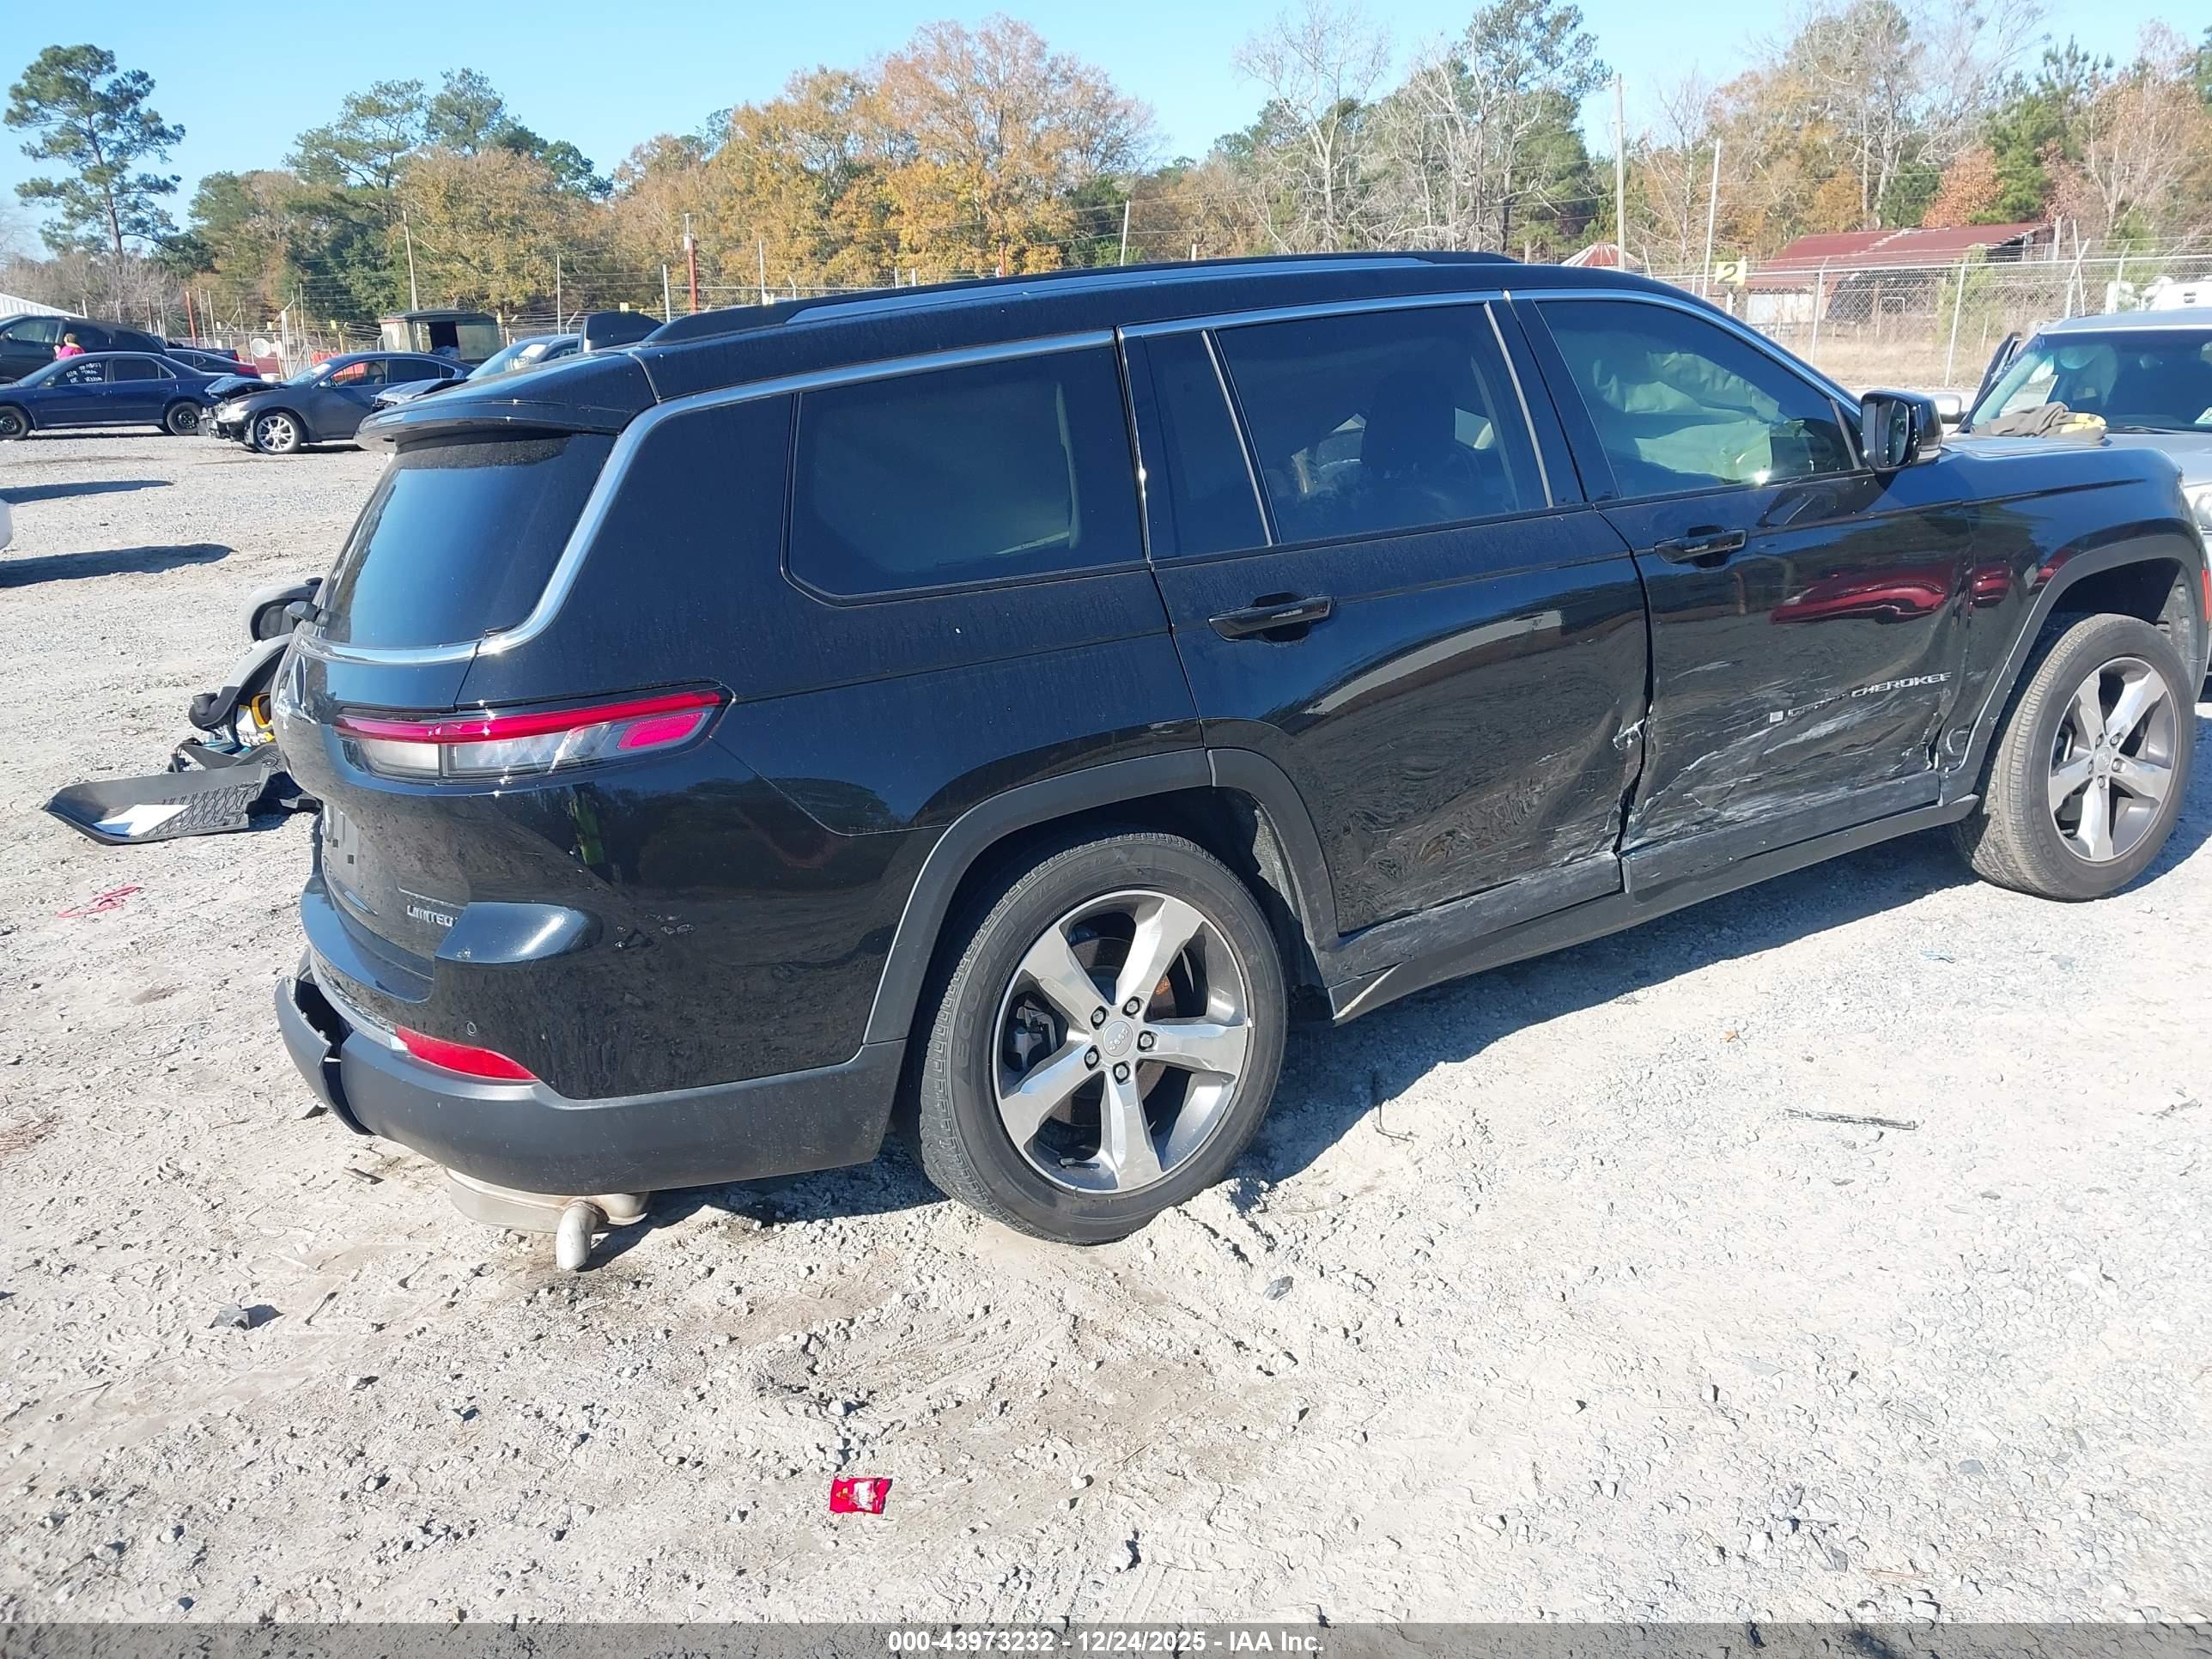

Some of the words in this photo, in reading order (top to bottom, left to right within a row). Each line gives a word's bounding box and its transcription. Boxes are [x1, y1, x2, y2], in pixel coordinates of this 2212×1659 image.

[1717, 263, 1738, 284] 2
[1850, 672, 1952, 698] CHEROKEE
[406, 904, 454, 927] LIMITED
